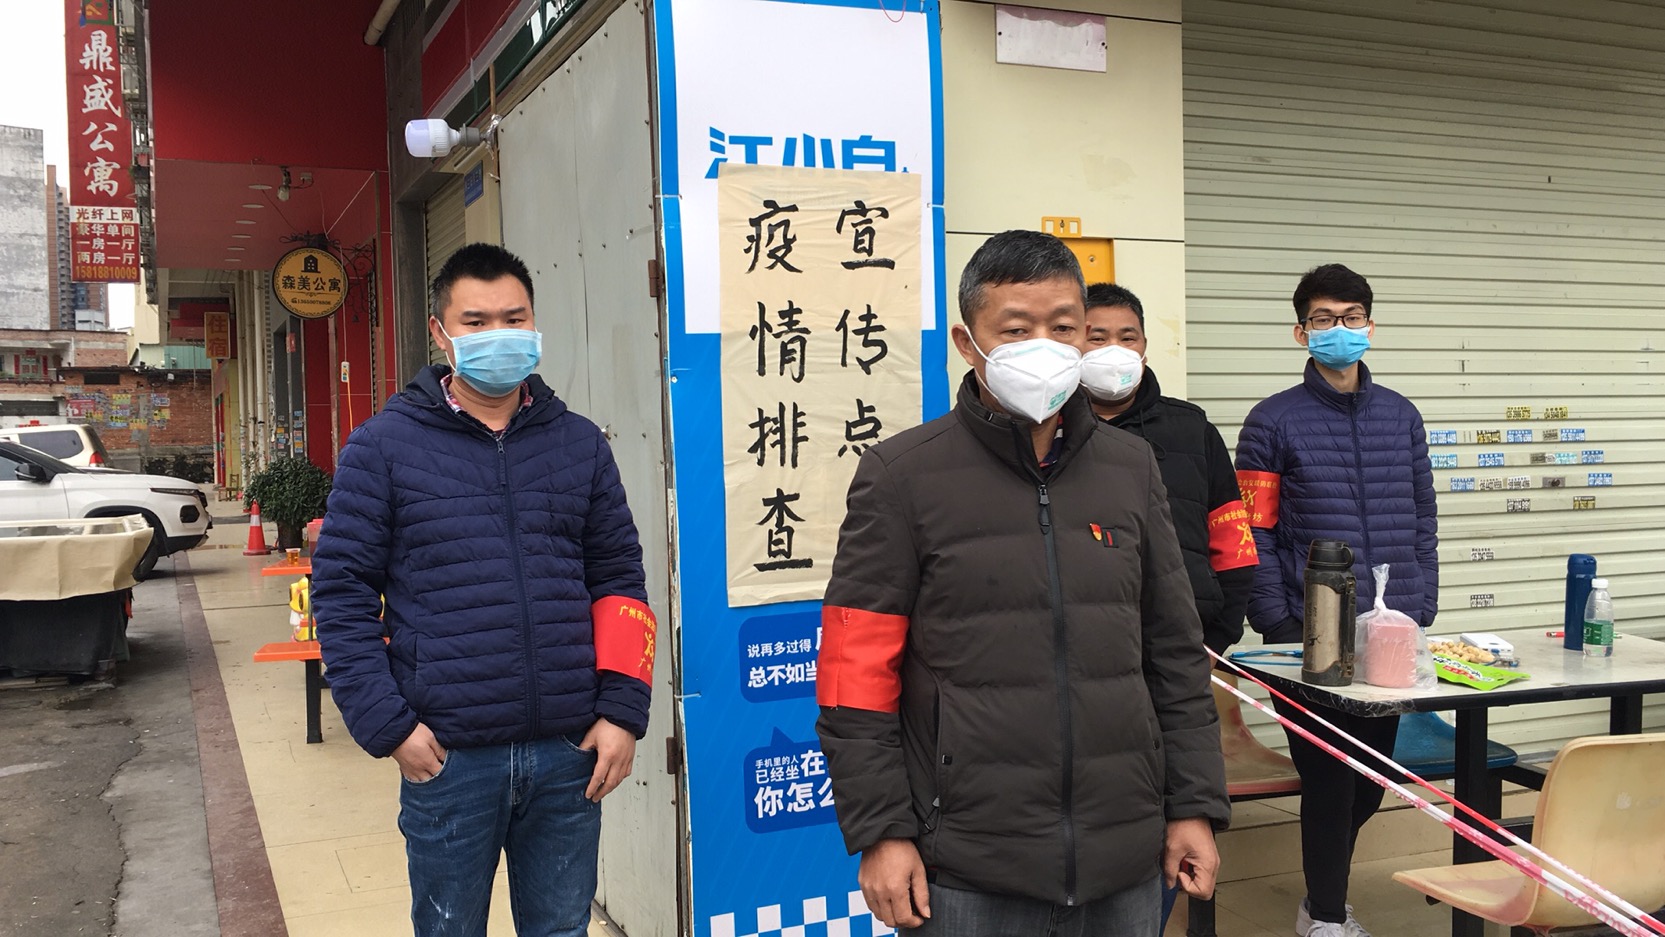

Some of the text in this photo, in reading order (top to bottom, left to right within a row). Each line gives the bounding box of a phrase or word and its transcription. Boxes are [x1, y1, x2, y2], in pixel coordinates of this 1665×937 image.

[79, 29, 122, 198] 鼎盛公寓
[704, 126, 896, 179] 江小白
[76, 207, 134, 221] 光纤上网
[76, 222, 135, 237] 豪华单间
[76, 238, 135, 250] 一房一厅
[76, 252, 136, 265] 两房一厅
[75, 265, 138, 279] 15818810009
[281, 274, 341, 293] 森美公寓
[207, 315, 229, 358] 住宿
[835, 200, 895, 457] 宣传点
[743, 199, 813, 572] 疫情排查
[747, 638, 812, 658] 说再多过得
[747, 660, 817, 688] 总不如当
[755, 755, 799, 769] 手机里的人
[800, 749, 826, 777] 在
[755, 764, 800, 785] 已经坐
[753, 777, 836, 819] 你怎么
